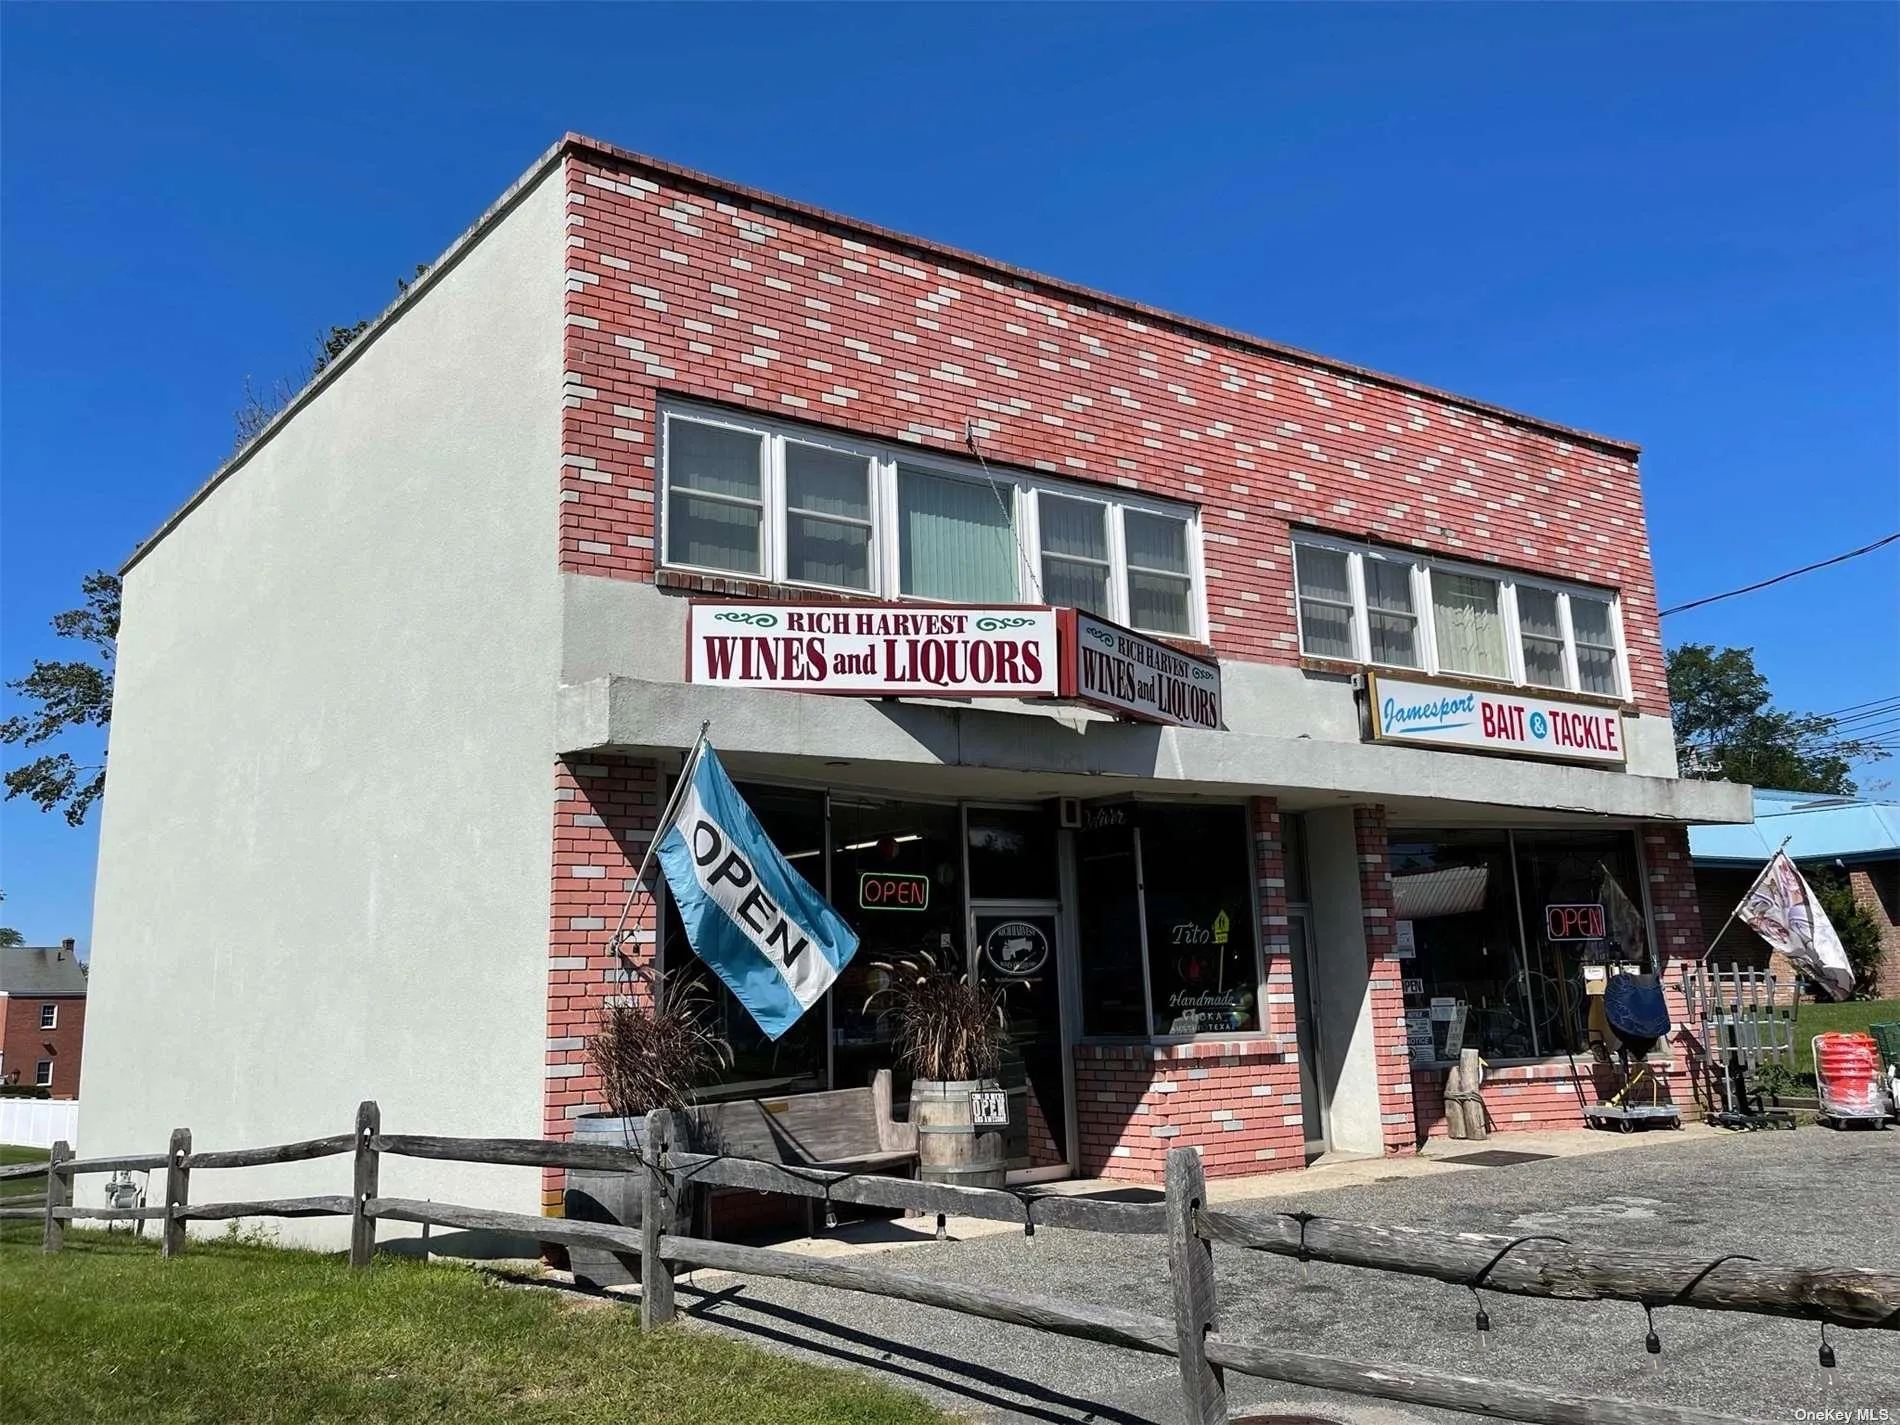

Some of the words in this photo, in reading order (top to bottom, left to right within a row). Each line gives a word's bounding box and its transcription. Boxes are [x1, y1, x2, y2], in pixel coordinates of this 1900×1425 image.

[786, 612, 851, 635] RICH
[855, 613, 968, 636] HARVEST
[703, 636, 828, 682] WINES
[832, 644, 877, 675] and
[883, 639, 1043, 687] LIQUORS
[1118, 636, 1145, 664] RICH
[1146, 645, 1190, 678] HARVEST
[1082, 646, 1136, 703] WINES
[1137, 675, 1156, 703] and
[1157, 673, 1217, 729] LIQUORS
[1384, 693, 1475, 733] Jamesport
[1481, 701, 1526, 741] BAIT
[1532, 715, 1547, 736] &
[1549, 711, 1618, 751] TACKLE
[693, 820, 809, 969] OPEN
[865, 880, 924, 904] OPEN
[1549, 908, 1602, 936] OPEN
[1169, 989, 1234, 1007] Handmade
[1404, 980, 1422, 992] PEN
[973, 1100, 1006, 1116] OPEN
